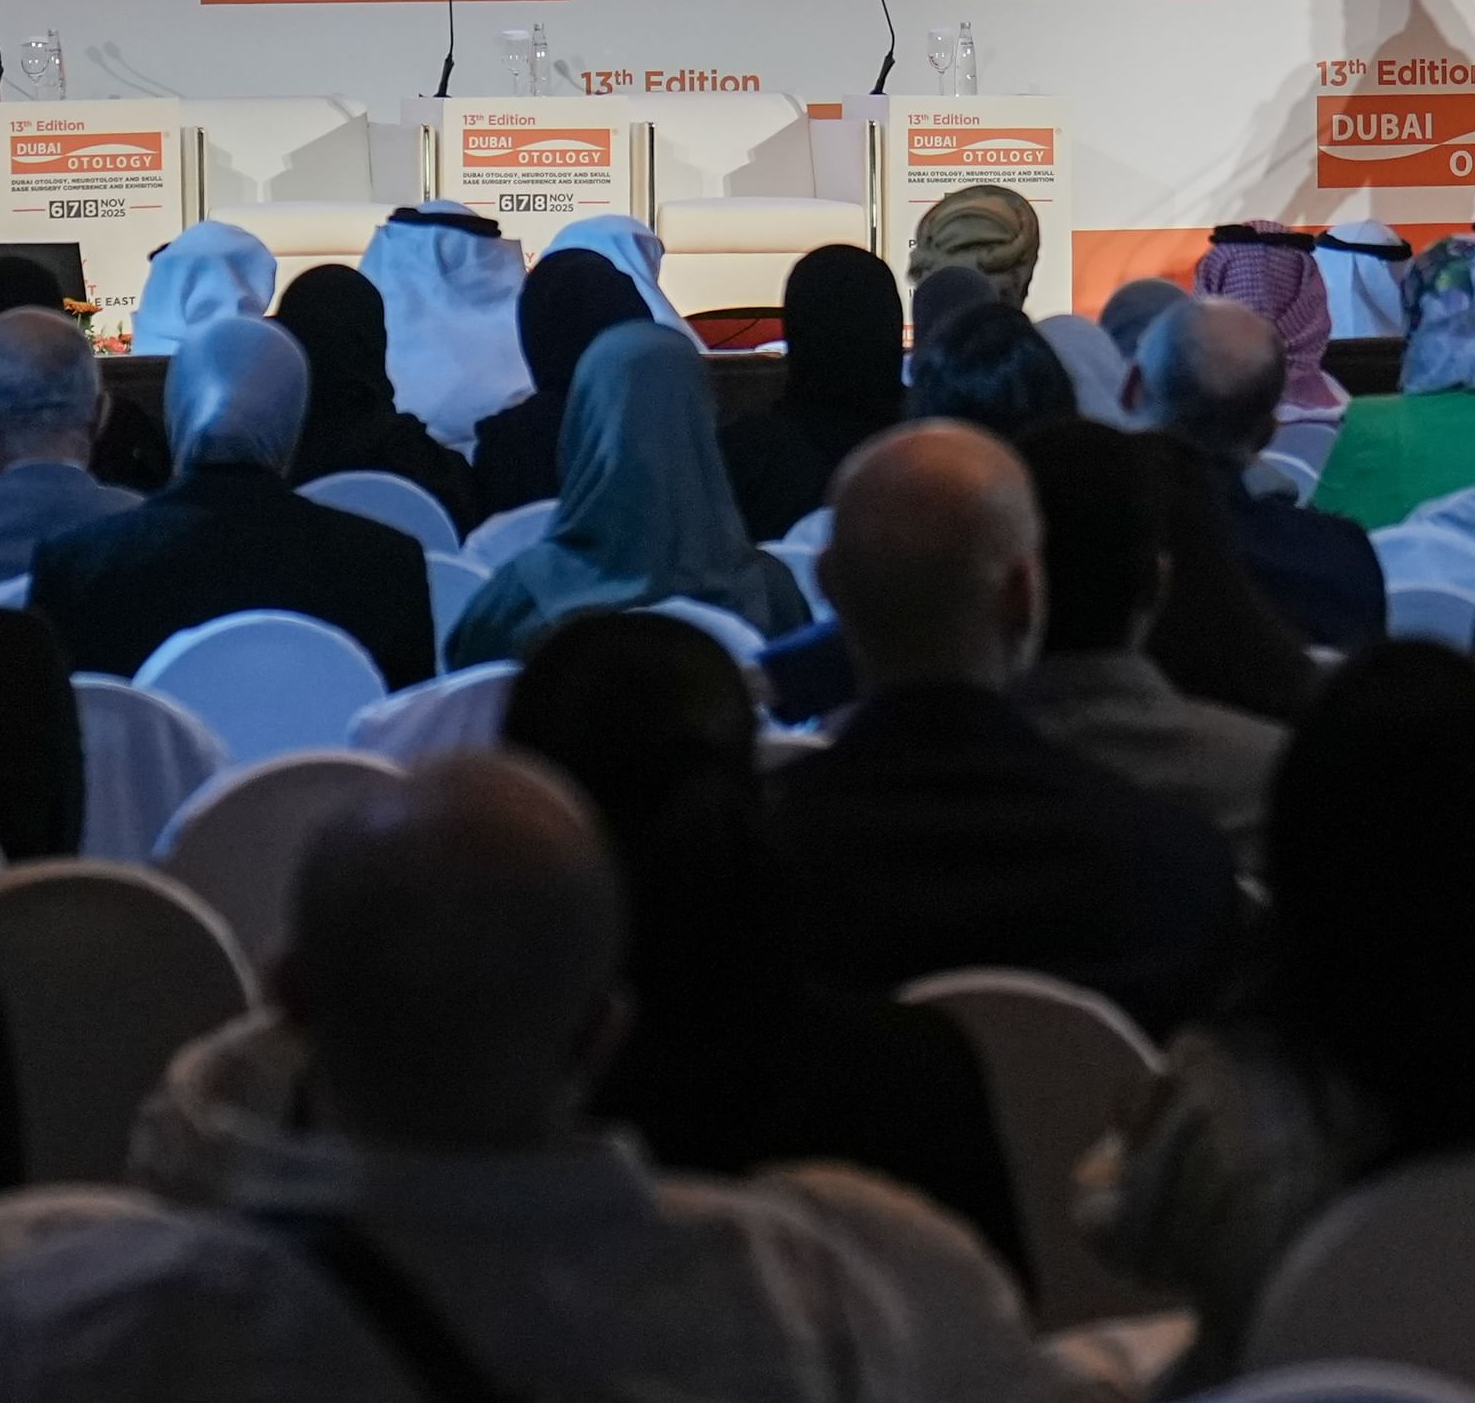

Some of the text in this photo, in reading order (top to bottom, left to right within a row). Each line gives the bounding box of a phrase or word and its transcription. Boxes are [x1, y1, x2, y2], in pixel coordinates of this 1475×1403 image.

[1316, 59, 1366, 87] 13th
[581, 69, 759, 95] 13th Edition
[463, 115, 535, 126] 13th Edition
[908, 114, 979, 125] 13th Edition
[10, 120, 84, 132] 13th Edition
[1331, 112, 1432, 141] DUBAI
[469, 137, 511, 148] DUBAI
[914, 136, 956, 147] DUBAI
[17, 143, 60, 154] DUBAI
[519, 152, 600, 163] OTOLOGY
[963, 151, 1044, 162] OTOLOGY
[68, 156, 152, 169] OTOLOGY
[101, 199, 125, 207] NOV
[550, 194, 573, 202] NOV
[101, 209, 125, 217] 2025
[550, 204, 573, 212] 2025
[106, 297, 135, 306] EAST
